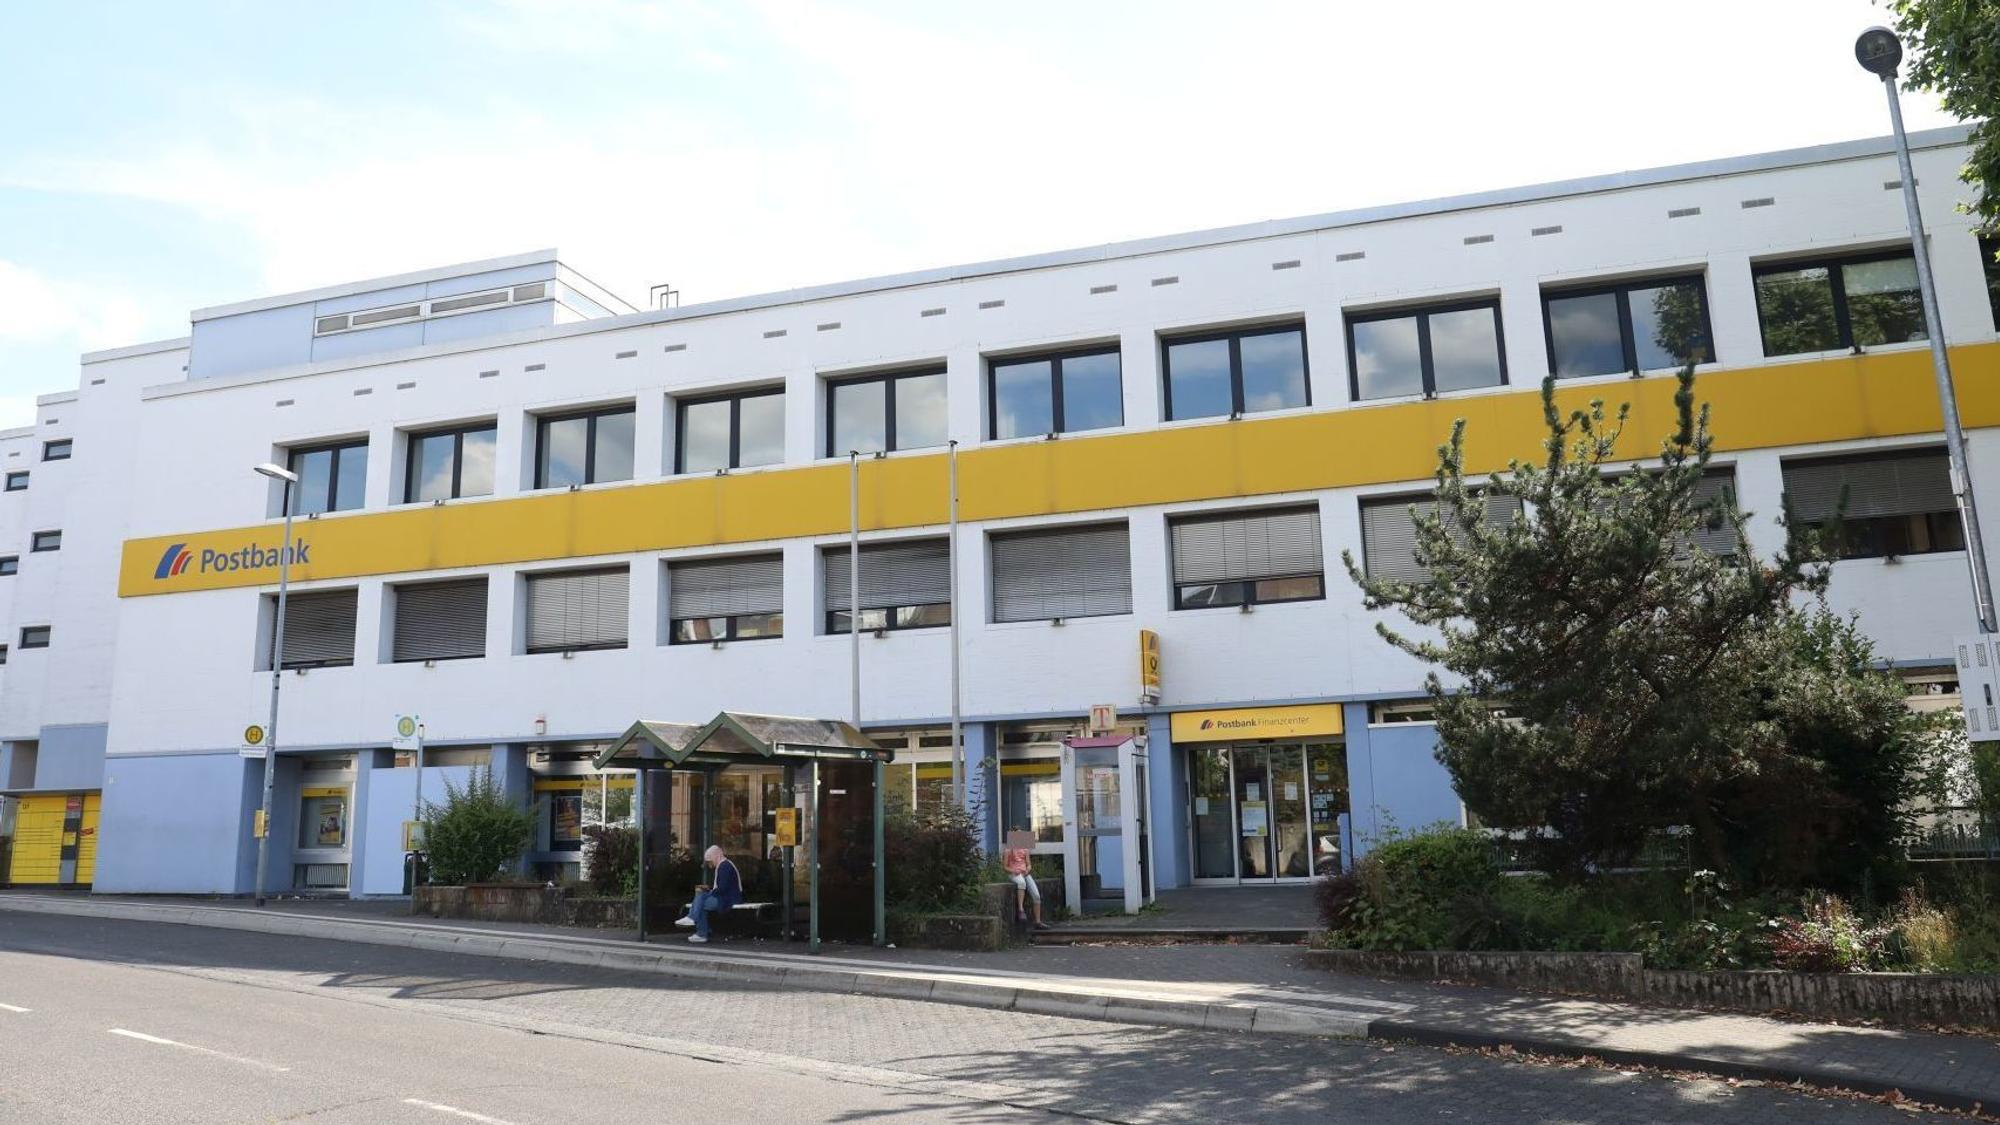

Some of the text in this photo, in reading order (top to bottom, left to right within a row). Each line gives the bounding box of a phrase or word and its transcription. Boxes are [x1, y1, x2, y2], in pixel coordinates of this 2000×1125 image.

[201, 538, 310, 573] Postbank
[1093, 707, 1110, 728] T
[1217, 716, 1310, 729] Postbank Finanzcenter
